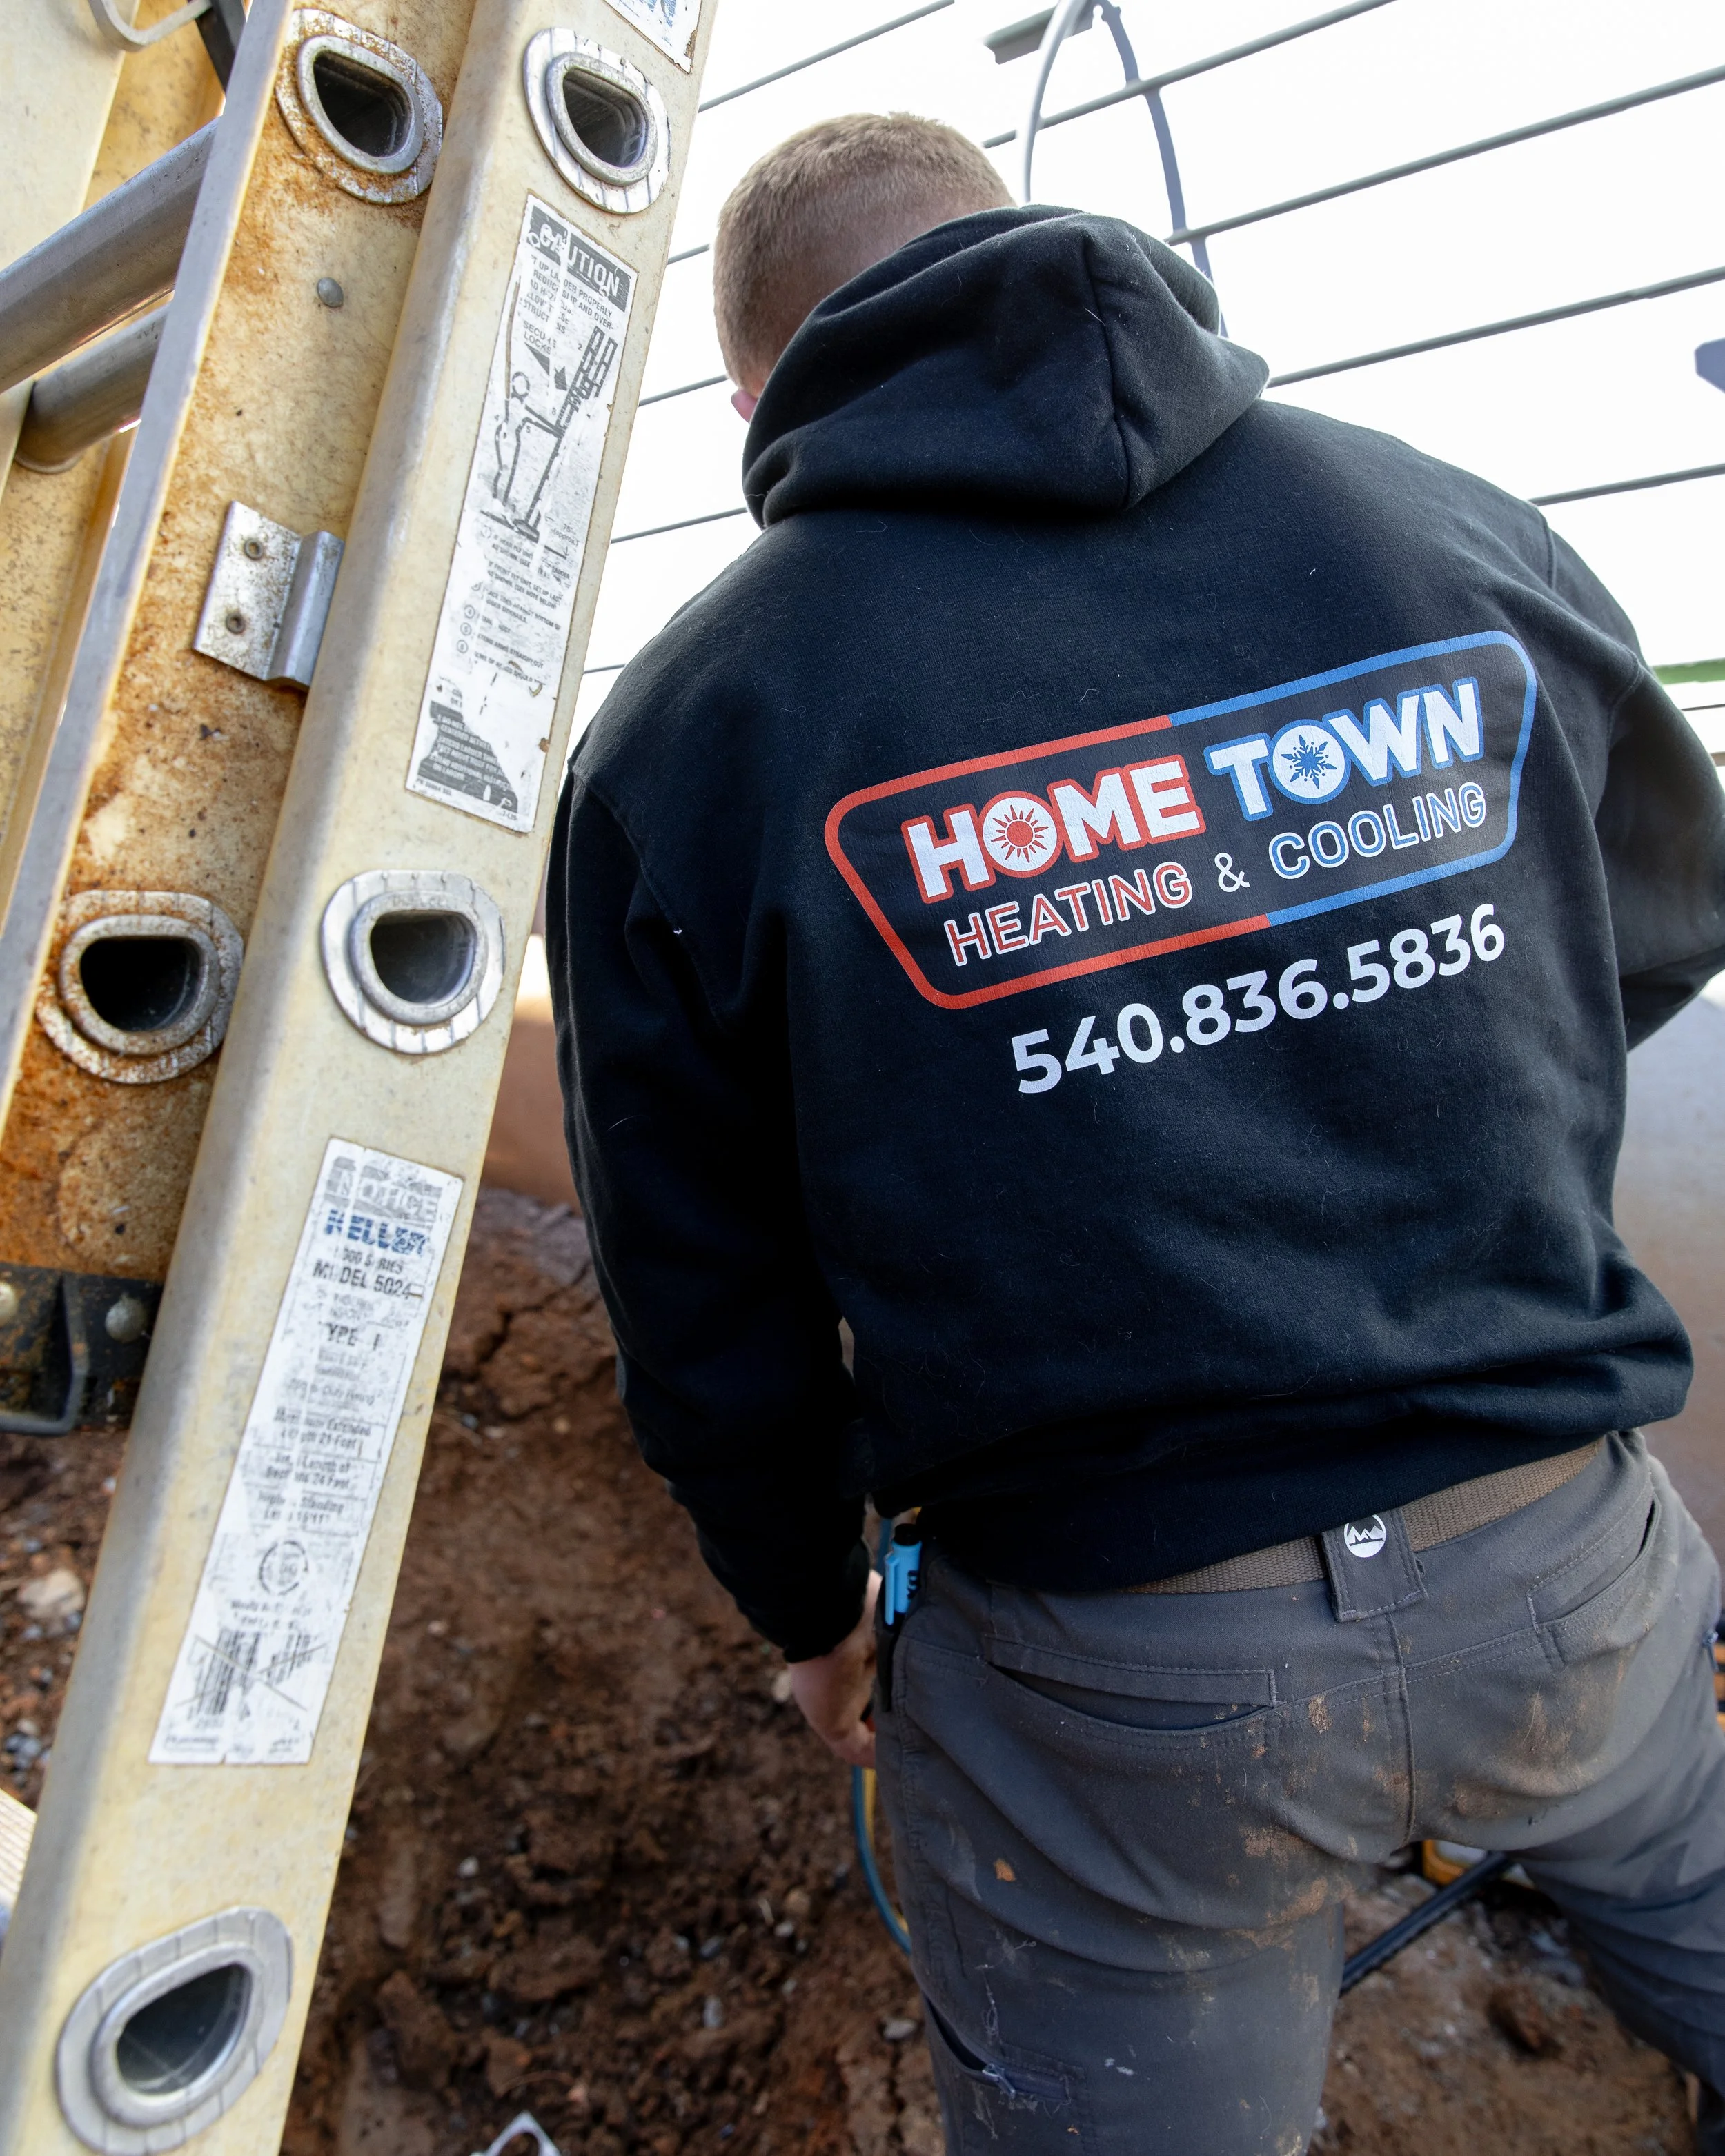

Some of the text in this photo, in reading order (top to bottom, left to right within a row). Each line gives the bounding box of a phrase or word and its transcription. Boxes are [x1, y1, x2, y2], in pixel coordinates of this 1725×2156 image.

[540, 223, 620, 298] CAUTION
[578, 302, 593, 316] AND
[901, 677, 1483, 903] HOME TOWN
[945, 782, 1486, 967] HEATING & COOLING
[1010, 903, 1505, 1094] 540.836.5836
[313, 1258, 367, 1289] MDEL
[364, 1253, 405, 1275] SRIES
